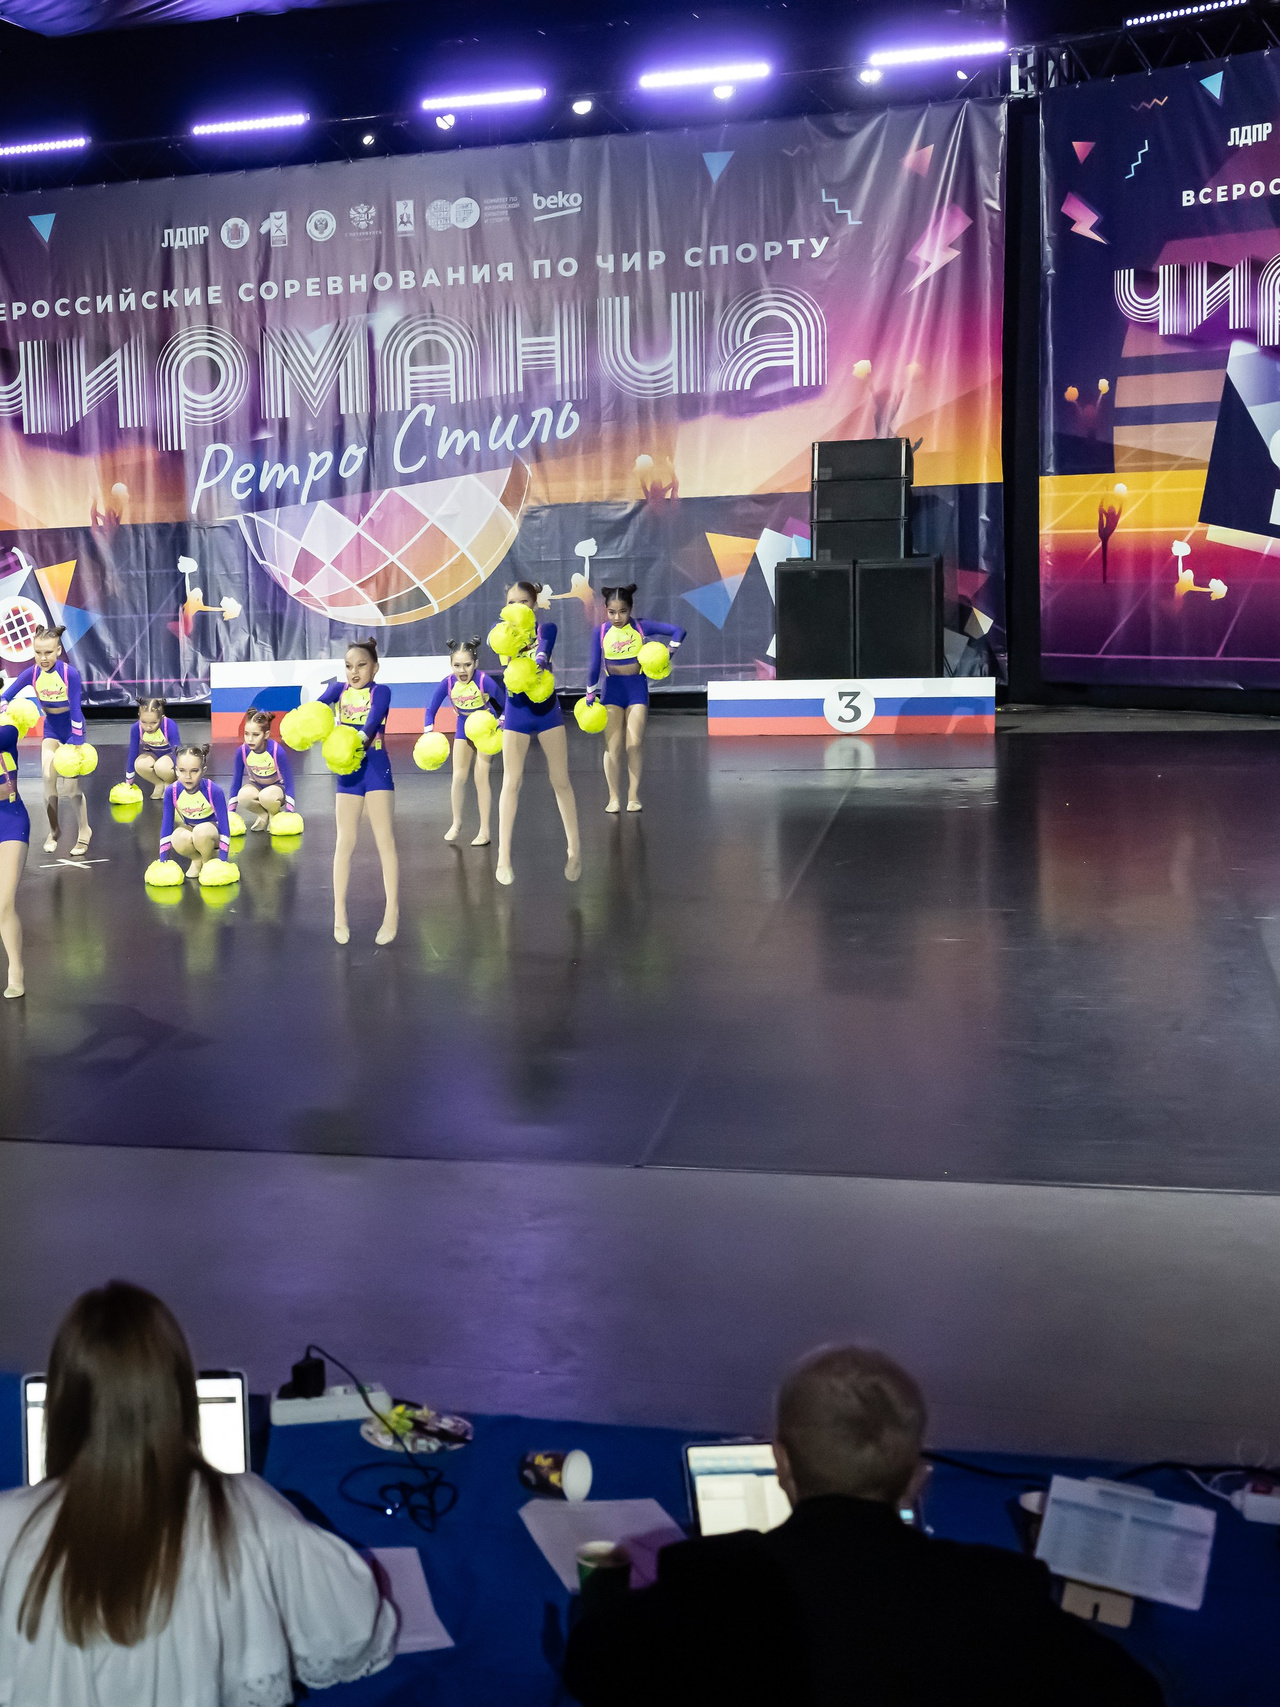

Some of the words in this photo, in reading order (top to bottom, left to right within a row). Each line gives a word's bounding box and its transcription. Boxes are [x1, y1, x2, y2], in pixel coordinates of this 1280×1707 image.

[1227, 122, 1273, 148] ЛДПР
[532, 190, 583, 210] beko
[161, 225, 210, 249] ЛДПР
[238, 262, 514, 302] СОРЕВНОВАНИЯ
[533, 257, 579, 279] ПО
[596, 250, 666, 273] ЧИР
[684, 236, 830, 267] СПОРТУ
[190, 442, 368, 514] Ретро
[393, 402, 581, 474] Стиль
[837, 691, 862, 723] 3
